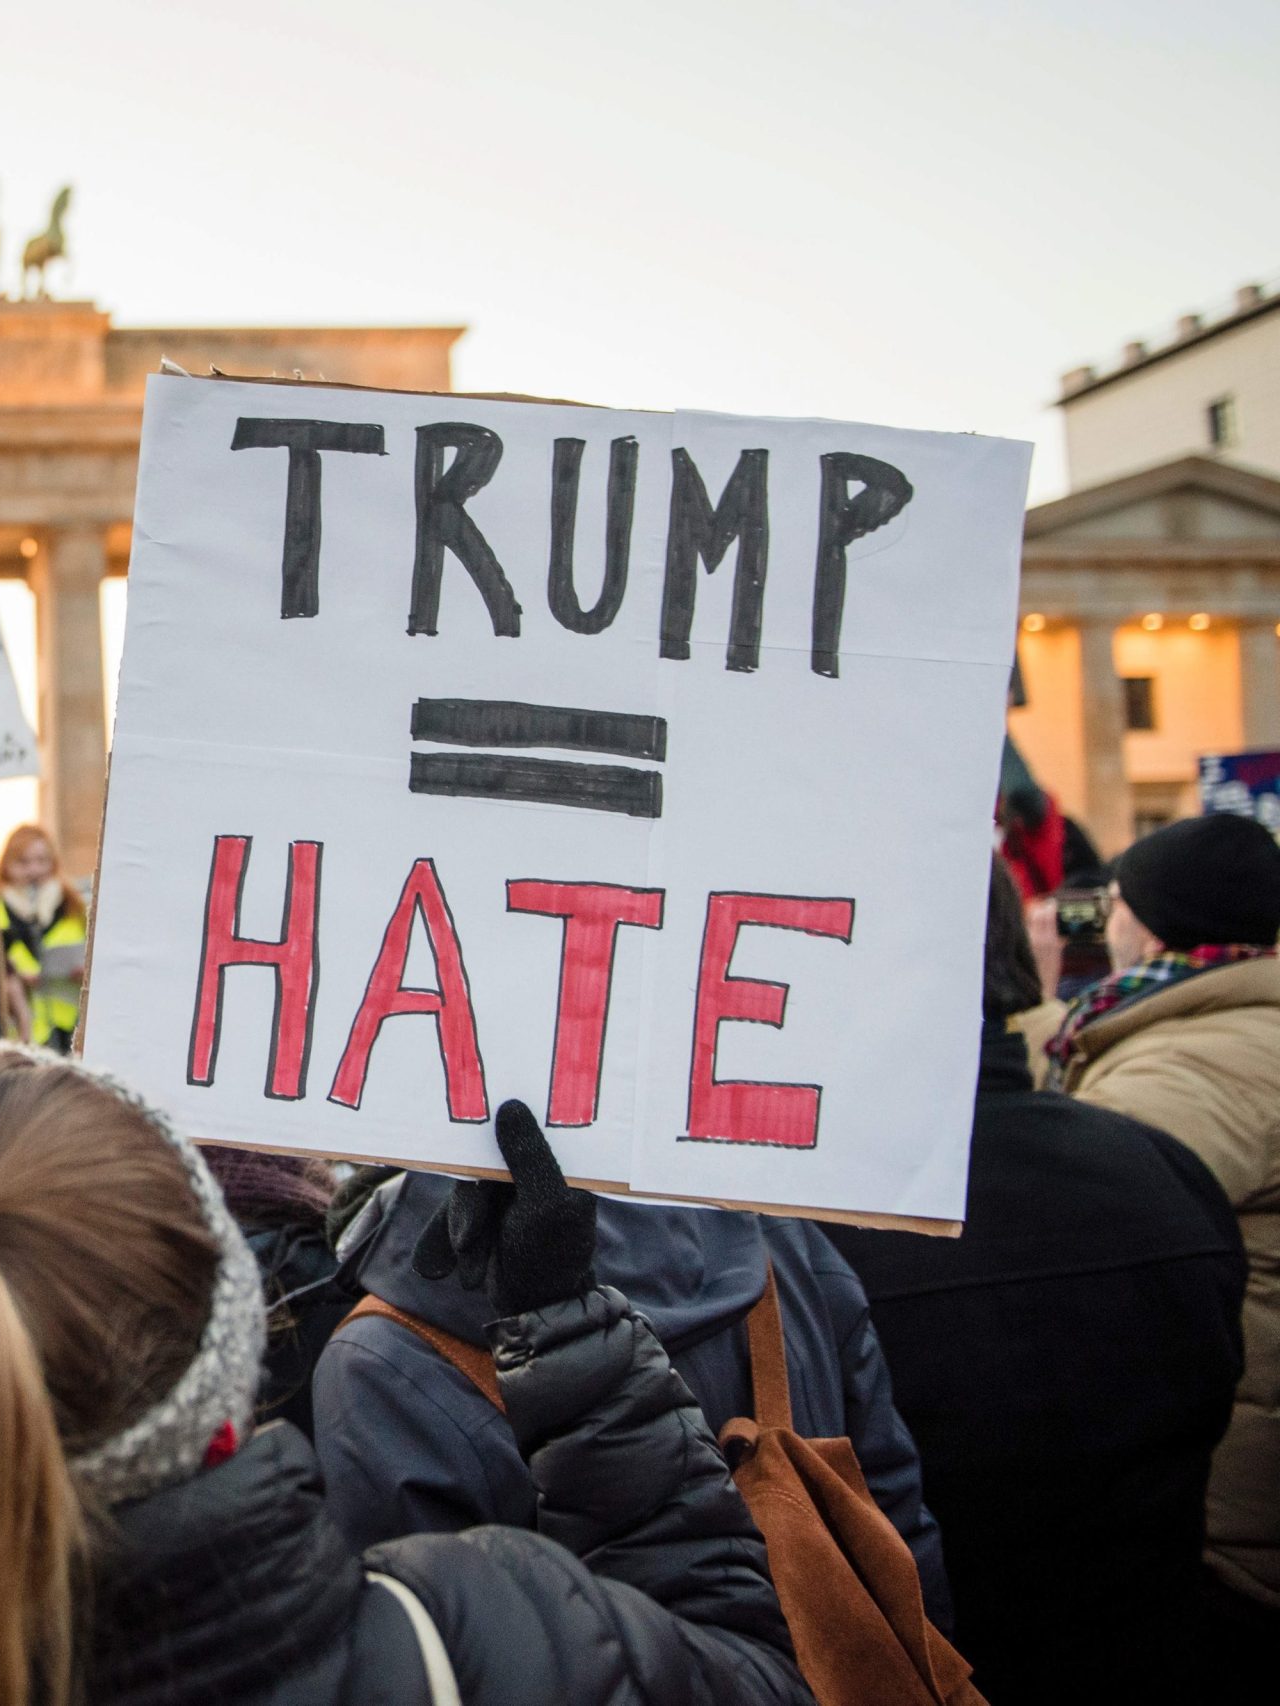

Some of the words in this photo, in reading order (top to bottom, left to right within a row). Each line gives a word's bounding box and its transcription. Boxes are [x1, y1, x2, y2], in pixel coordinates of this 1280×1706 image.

[230, 417, 914, 678] TRUMP
[408, 698, 667, 818] =
[187, 834, 856, 1150] HATE
